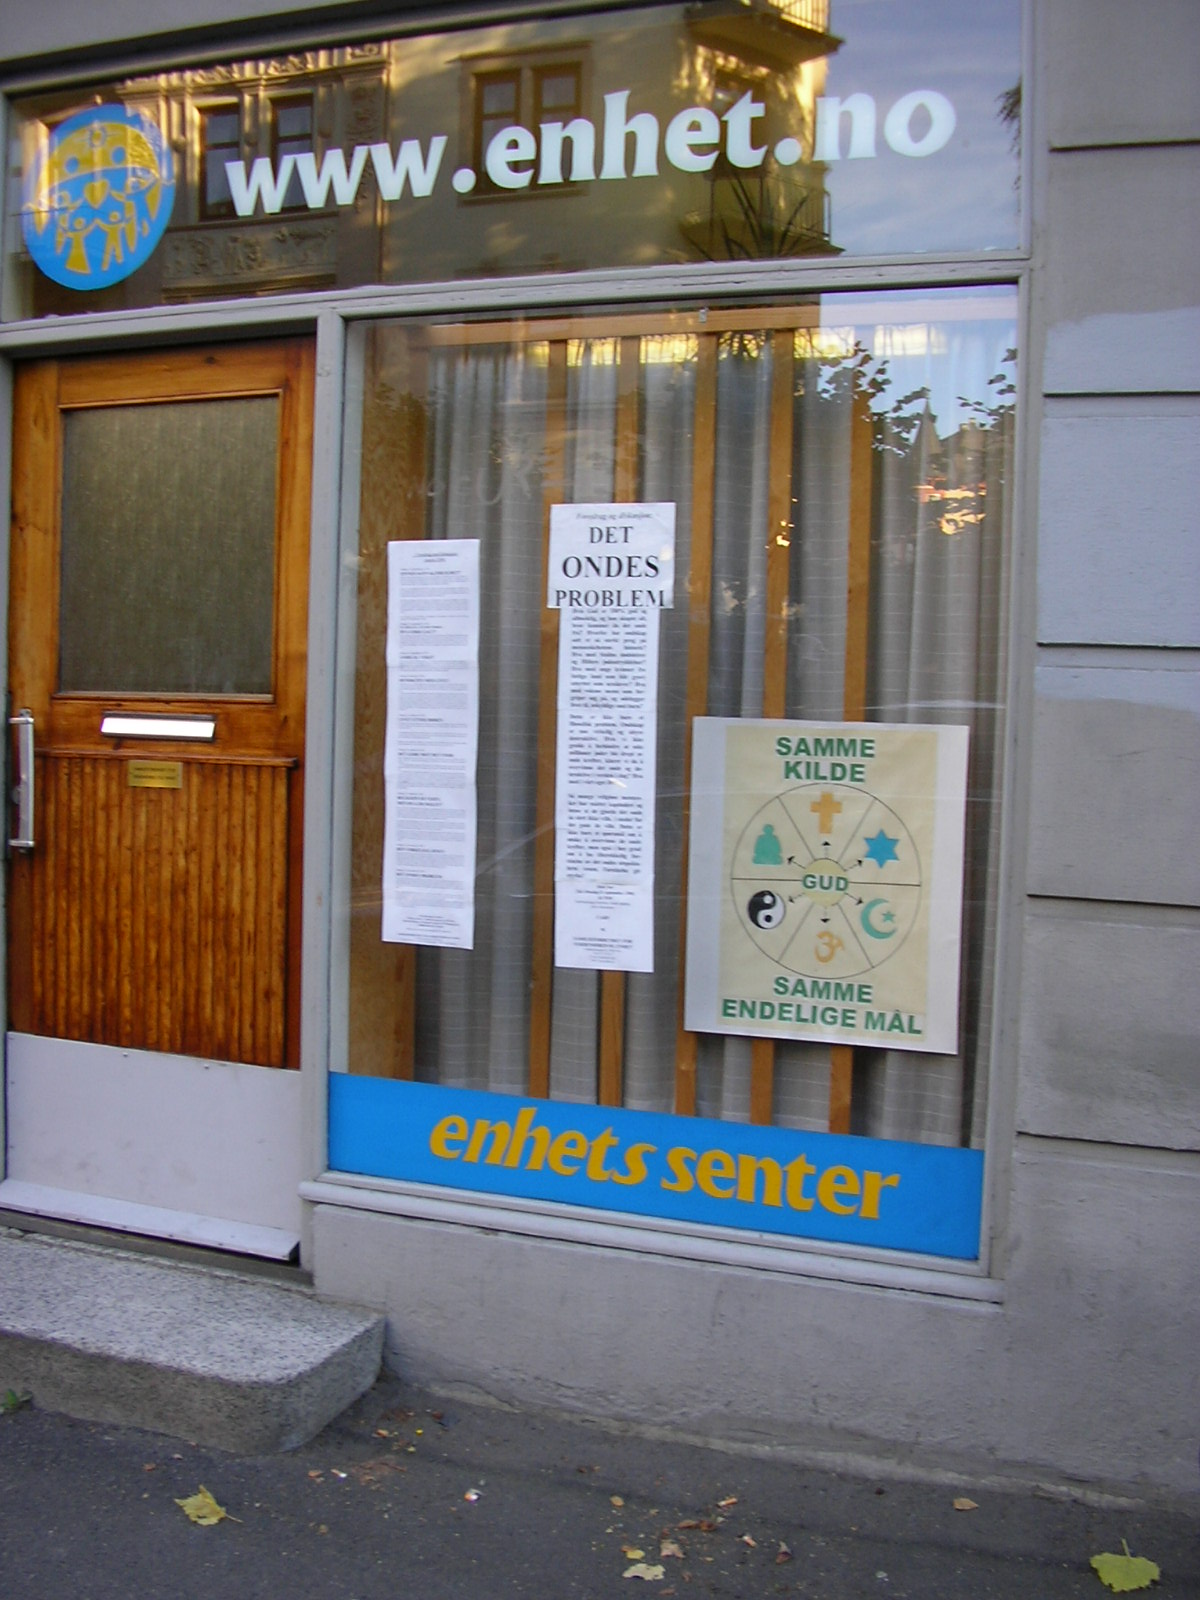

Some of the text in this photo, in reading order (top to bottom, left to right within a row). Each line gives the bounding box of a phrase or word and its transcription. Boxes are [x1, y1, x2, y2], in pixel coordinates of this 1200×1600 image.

[224, 90, 956, 217] www.enhet.no
[589, 526, 634, 543] DET
[562, 555, 659, 578] ONDES
[555, 589, 665, 607] PROBLEM
[775, 736, 875, 759] SAMME
[784, 761, 866, 783] KILDE
[802, 873, 849, 892] GUD
[773, 976, 873, 1004] SAMME
[721, 998, 922, 1035] ENDELIGE MÅL
[429, 1107, 900, 1220] enhets senter
